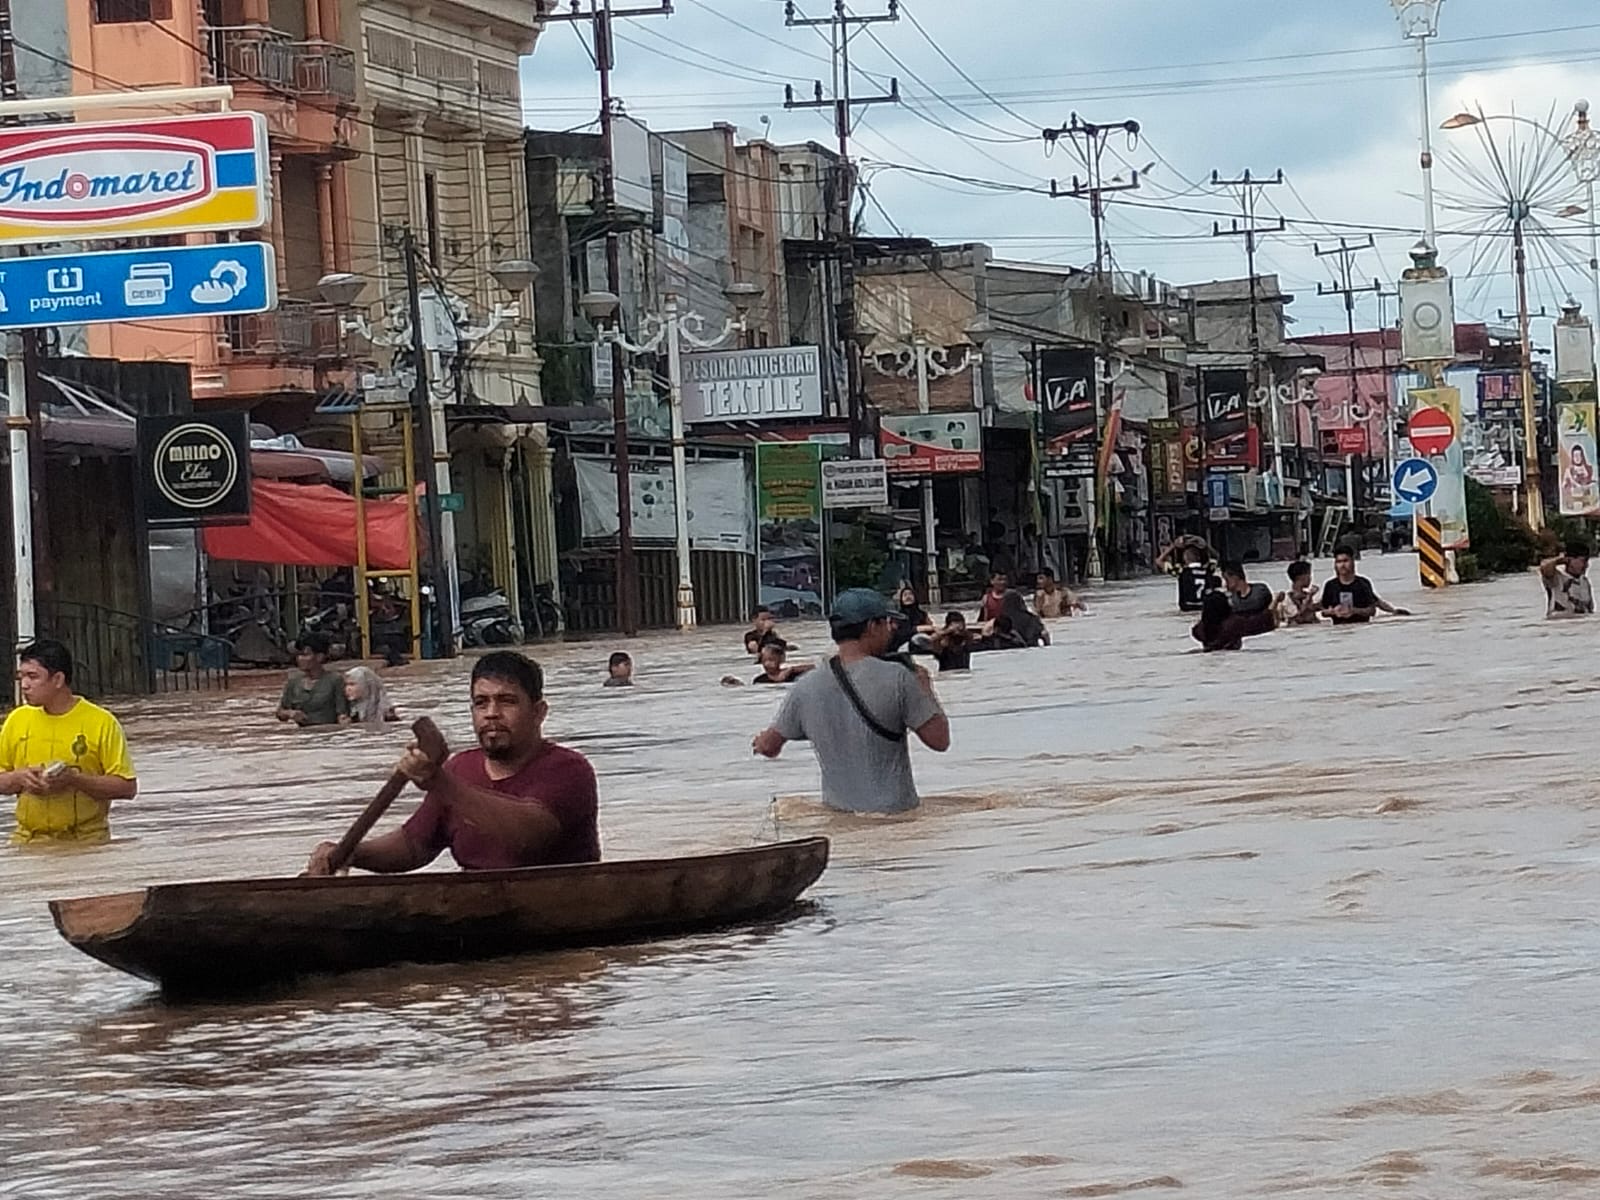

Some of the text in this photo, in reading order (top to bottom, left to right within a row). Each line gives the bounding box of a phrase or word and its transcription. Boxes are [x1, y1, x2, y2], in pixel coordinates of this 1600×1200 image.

[0, 160, 195, 203] Indomaret
[30, 291, 102, 313] payment
[131, 289, 163, 299] DEBIT
[684, 352, 814, 380] PESONA ANUGERAH
[699, 378, 803, 417] TEXTILE
[1194, 578, 1206, 599] 7
